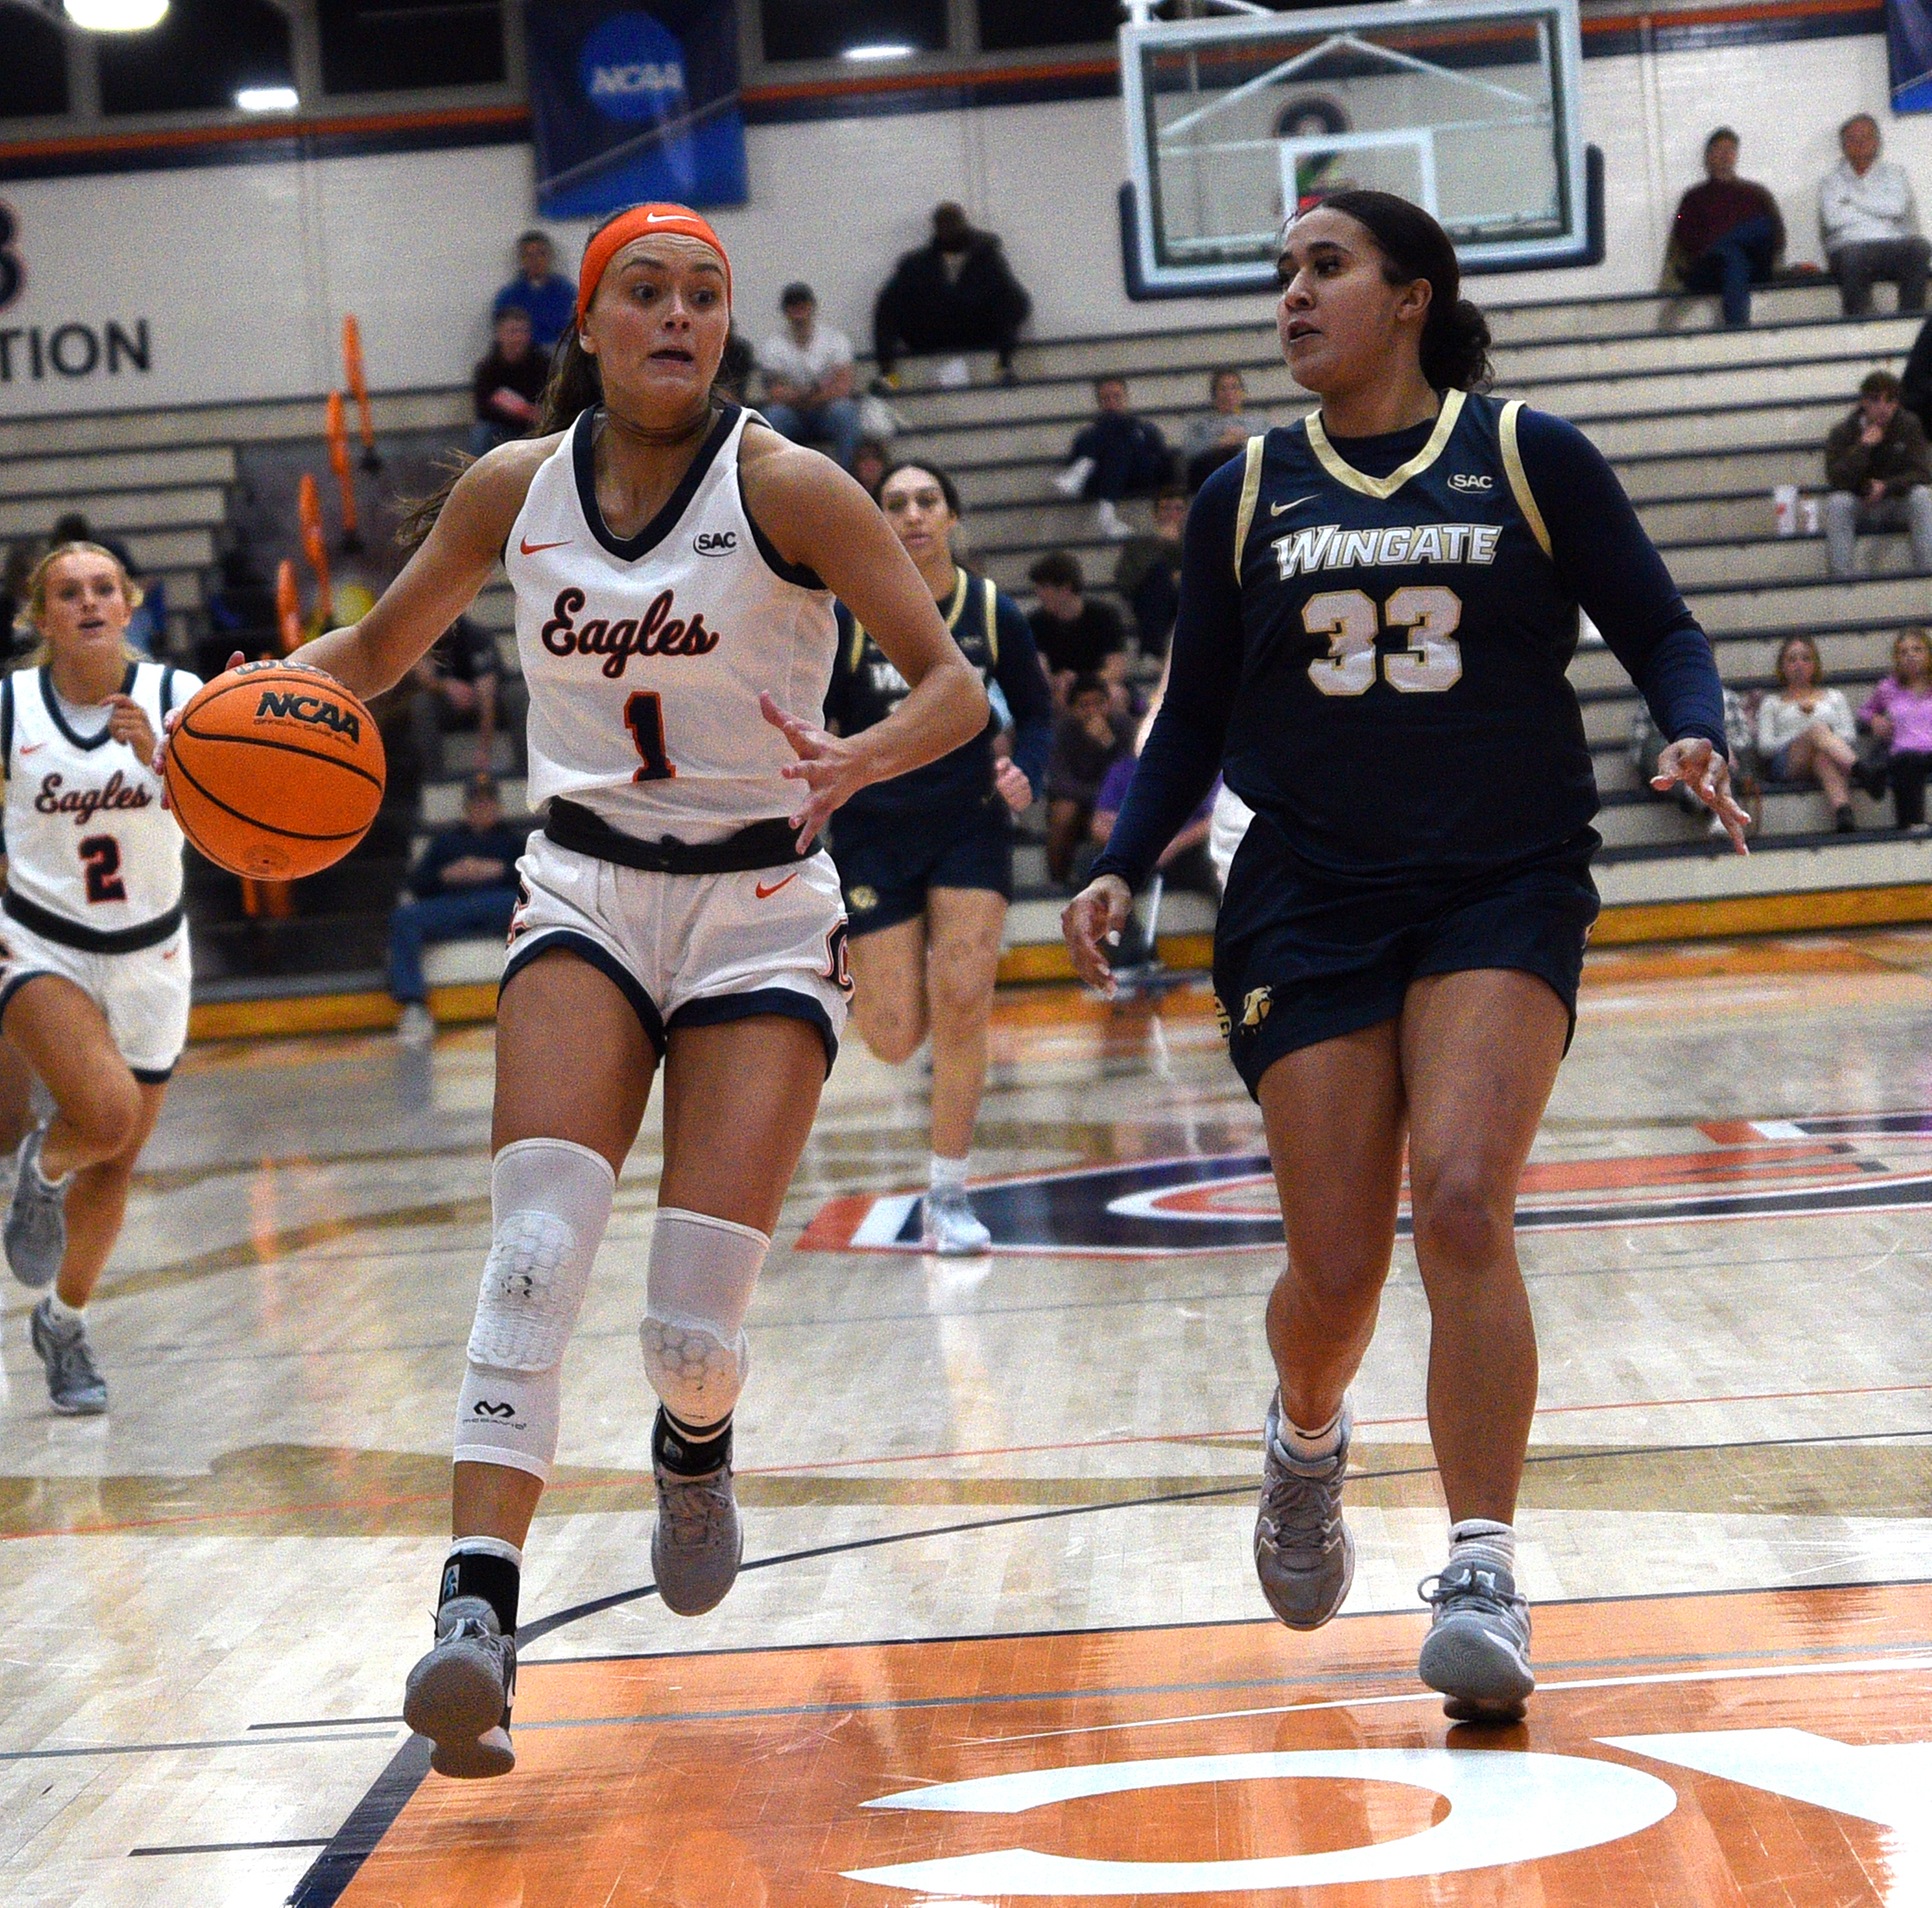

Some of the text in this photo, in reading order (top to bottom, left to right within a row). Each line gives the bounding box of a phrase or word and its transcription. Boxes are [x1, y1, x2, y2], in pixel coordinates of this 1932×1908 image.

[592, 63, 683, 93] NCAA
[1453, 474, 1493, 488] SAC
[698, 531, 737, 550] SAC
[1271, 523, 1503, 581] WINGATE
[541, 587, 719, 678] Eagles
[1301, 585, 1463, 696] 33
[256, 690, 359, 743] NCAA
[624, 691, 676, 781] 1
[35, 769, 153, 825] Eagles
[79, 834, 127, 903] 2
